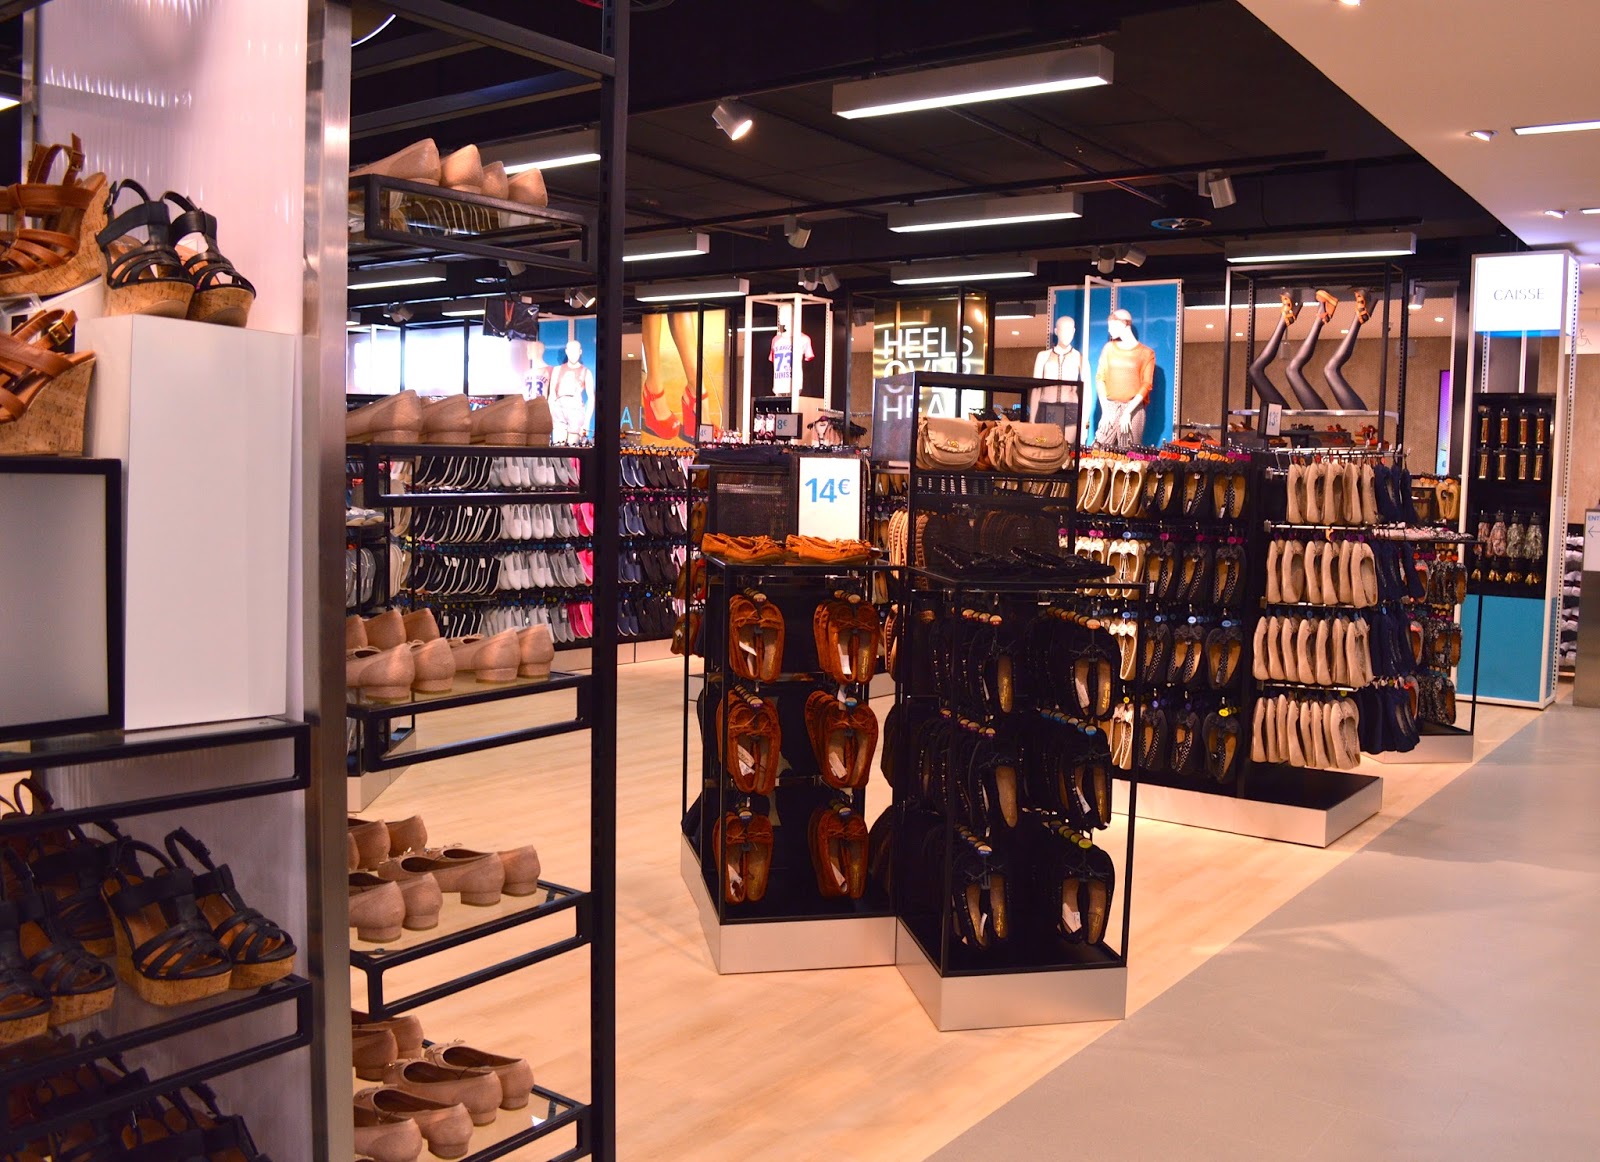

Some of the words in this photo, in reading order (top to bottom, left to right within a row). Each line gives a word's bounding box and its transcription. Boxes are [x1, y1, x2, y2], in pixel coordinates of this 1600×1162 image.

[1493, 288, 1544, 301] CAISSE
[883, 325, 974, 359] HEELS
[882, 393, 946, 422] HEA
[804, 477, 850, 503] 14€
